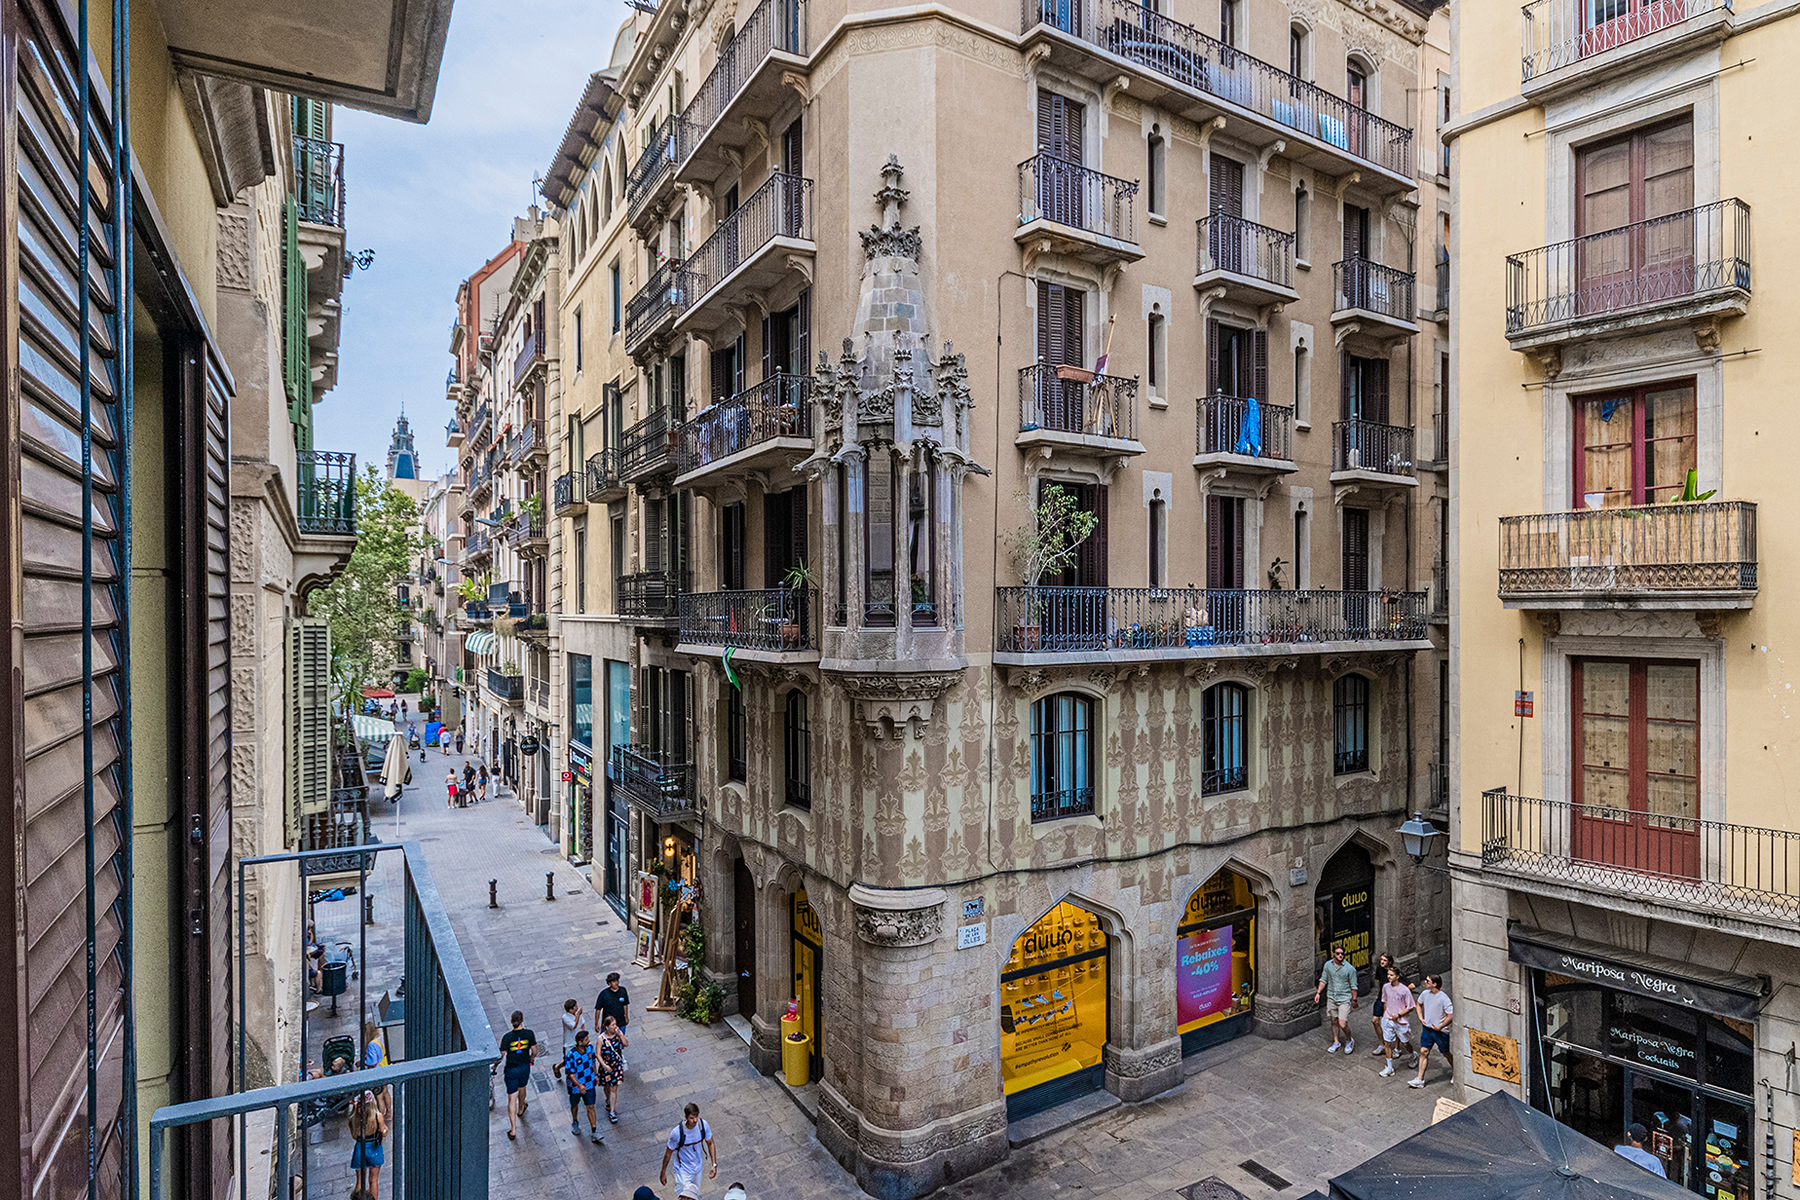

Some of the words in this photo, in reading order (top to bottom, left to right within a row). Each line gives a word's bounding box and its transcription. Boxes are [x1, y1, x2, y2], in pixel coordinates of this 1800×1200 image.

[82, 427, 90, 476] CORNING
[1341, 891, 1367, 908] duuo
[963, 936, 981, 945] OLLES
[1025, 929, 1072, 954] duuo
[1181, 945, 1228, 967] Rebaixes
[1191, 960, 1219, 976] -40%
[1561, 955, 1626, 981] Mariposa
[1630, 971, 1677, 994] Negra
[1610, 1026, 1659, 1049] Mariposa
[1660, 1040, 1695, 1059] Negra
[1637, 1050, 1680, 1069] Cocktails
